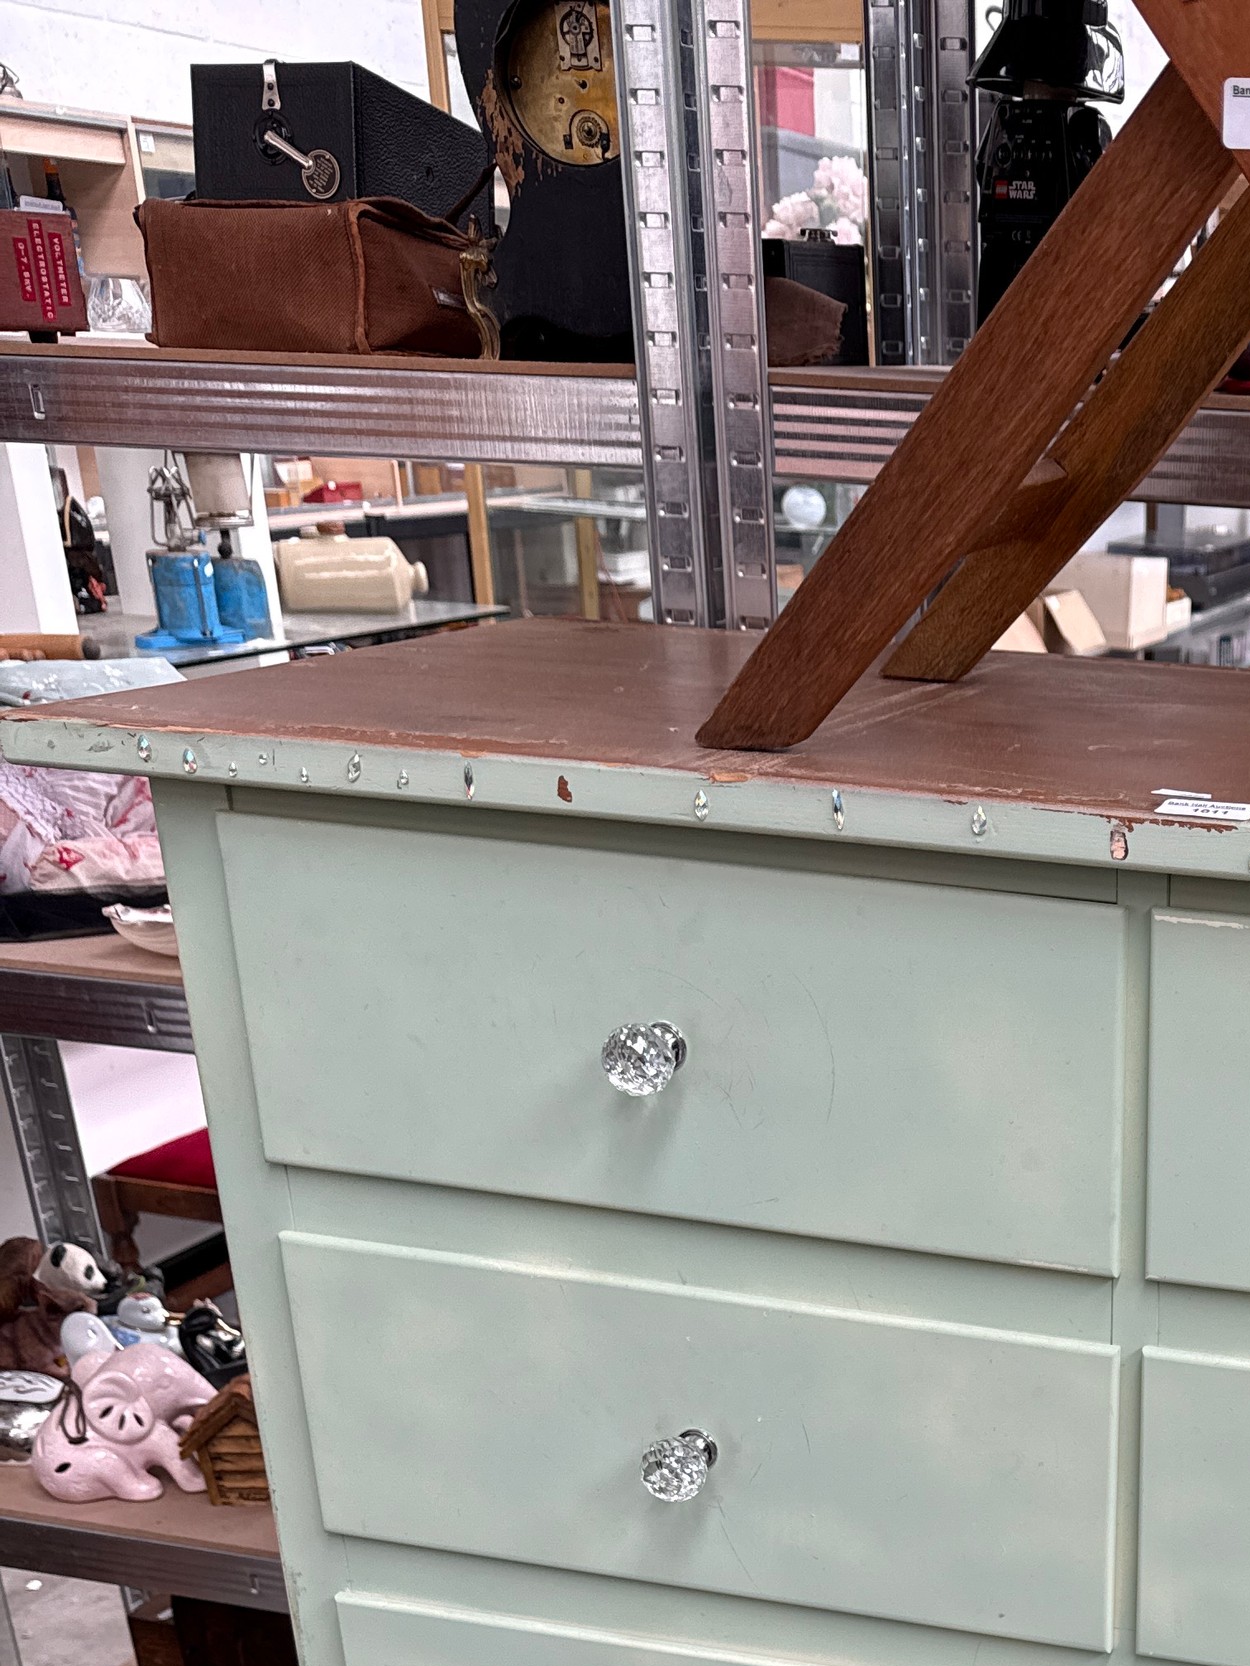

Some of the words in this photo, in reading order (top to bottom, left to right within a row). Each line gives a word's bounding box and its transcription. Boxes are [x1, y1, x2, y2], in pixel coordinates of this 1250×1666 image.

[1009, 180, 1036, 190] STAR
[1009, 190, 1036, 200] WARS
[31, 221, 55, 320] ELECTROSTATIC
[52, 236, 70, 304] VOLTMETER
